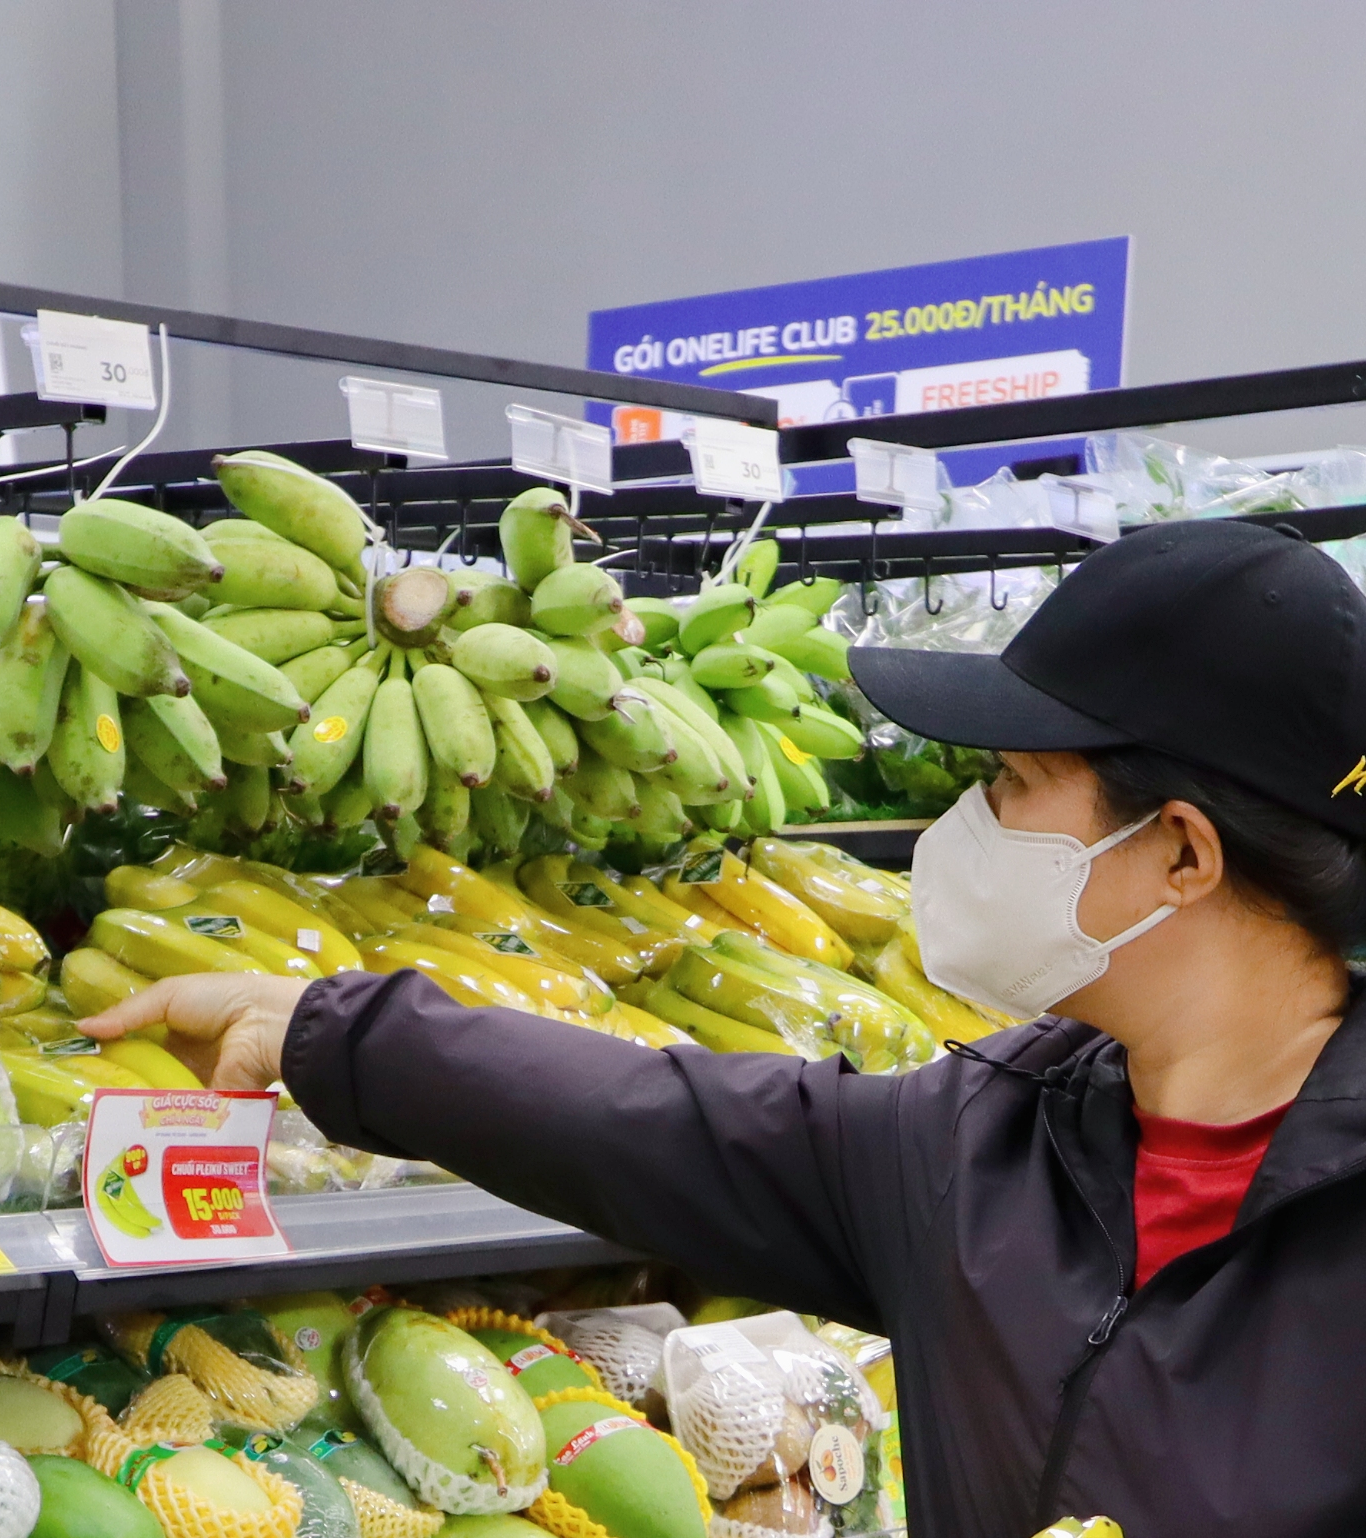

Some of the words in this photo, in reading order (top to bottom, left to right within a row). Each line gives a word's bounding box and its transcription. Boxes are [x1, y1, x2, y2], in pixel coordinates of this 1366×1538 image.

[614, 334, 663, 373] GÓI
[666, 326, 778, 365] ONELIFE
[782, 316, 857, 350] CLUB
[865, 281, 1094, 340] 25.000Đ/THÁNG
[100, 361, 126, 383] 30
[921, 371, 1059, 413] FREESHIP
[742, 461, 761, 479] 30
[153, 1093, 173, 1108] GIÁ
[174, 1094, 196, 1111] CỰC
[198, 1094, 220, 1110] SỐC
[182, 1188, 243, 1221] 15.000
[832, 1435, 848, 1492] Sapoche
